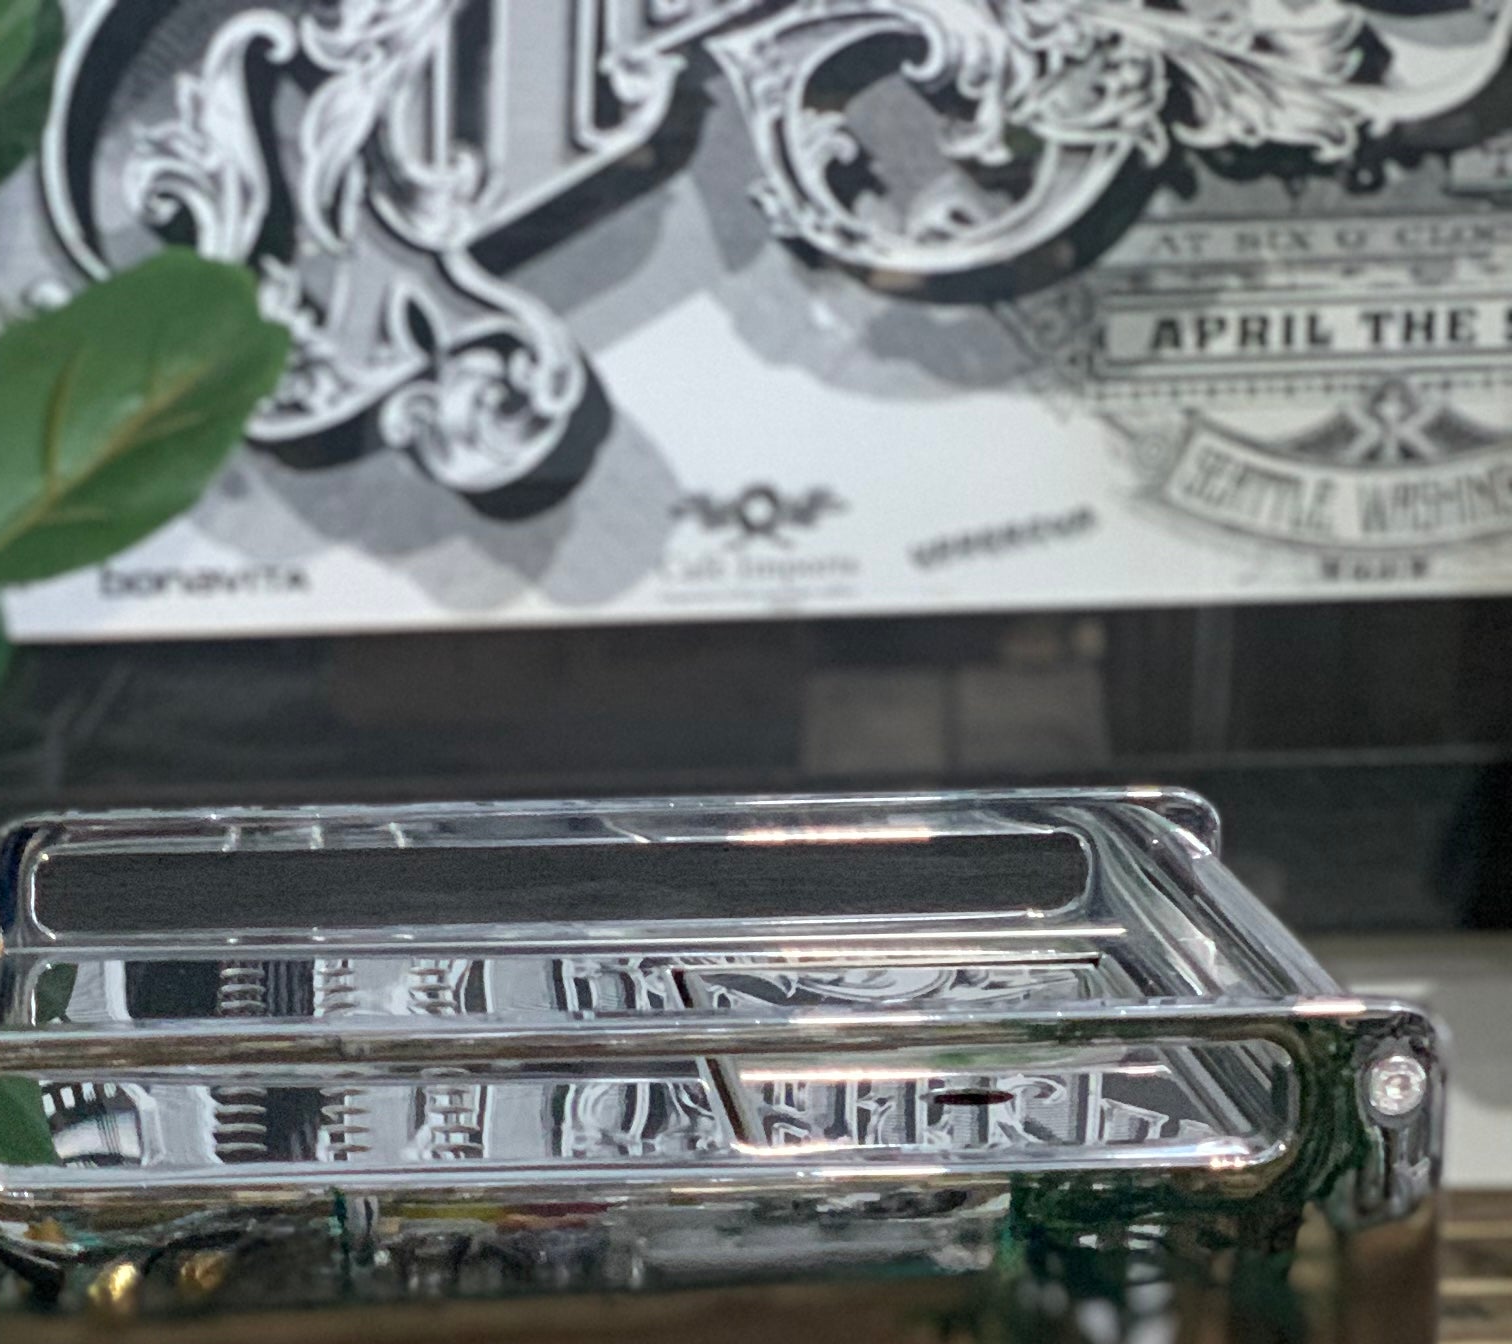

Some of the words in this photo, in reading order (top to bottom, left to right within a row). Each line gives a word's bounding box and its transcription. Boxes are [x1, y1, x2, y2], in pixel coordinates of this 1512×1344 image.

[1151, 312, 1333, 351] APRIL
[1360, 307, 1477, 346] THE
[1184, 447, 1335, 534] SEATTLE
